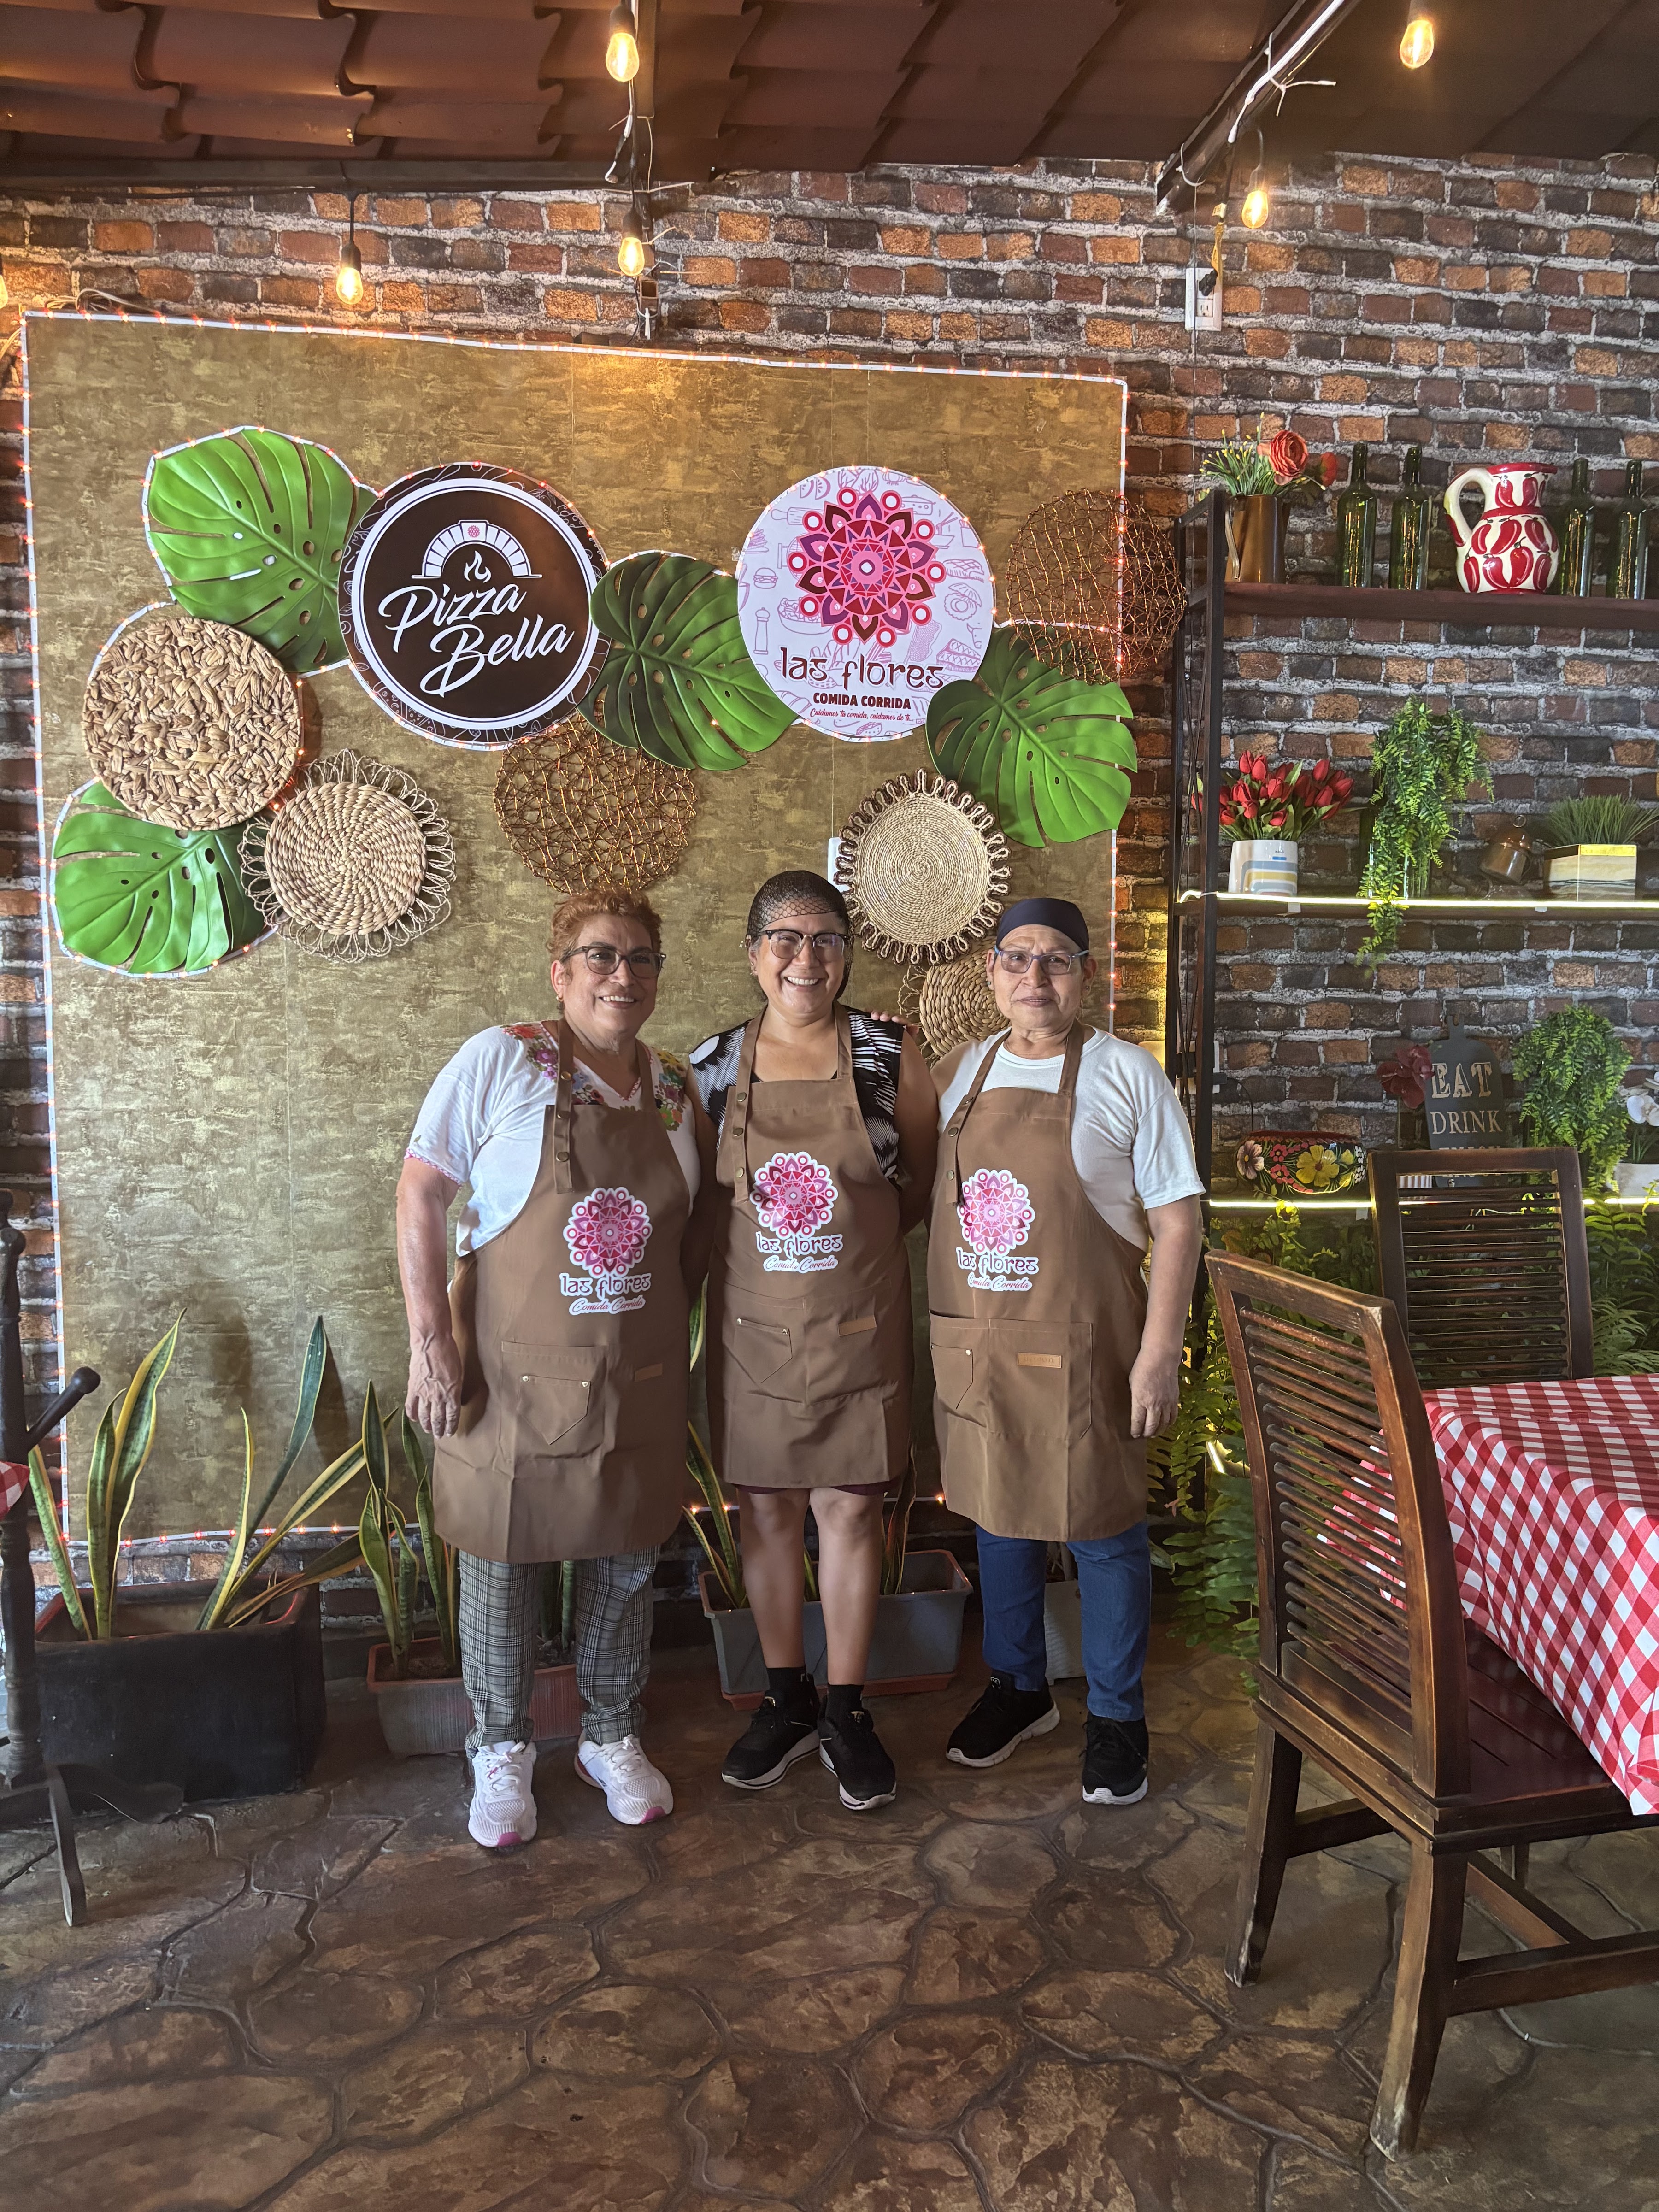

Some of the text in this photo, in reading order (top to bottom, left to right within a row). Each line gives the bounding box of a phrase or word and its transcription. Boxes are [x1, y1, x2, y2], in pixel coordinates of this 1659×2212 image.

[378, 583, 526, 653] Pizza
[420, 615, 575, 698] Bella
[780, 647, 943, 691] las flores
[813, 693, 911, 709] COMIDA CORRIDA
[810, 708, 838, 718] Cuidamos
[847, 711, 868, 719] comida,
[870, 711, 895, 720] cuidamos
[1432, 1062, 1492, 1098] EAT
[1430, 1110, 1503, 1135] DRINK
[757, 1234, 841, 1257] las flores
[765, 1256, 836, 1271] Comida Corrida
[958, 1249, 1037, 1273] las flores
[562, 1275, 651, 1297] las flores
[992, 1277, 1030, 1289] Corrida
[572, 1296, 643, 1313] Comida Corrida
